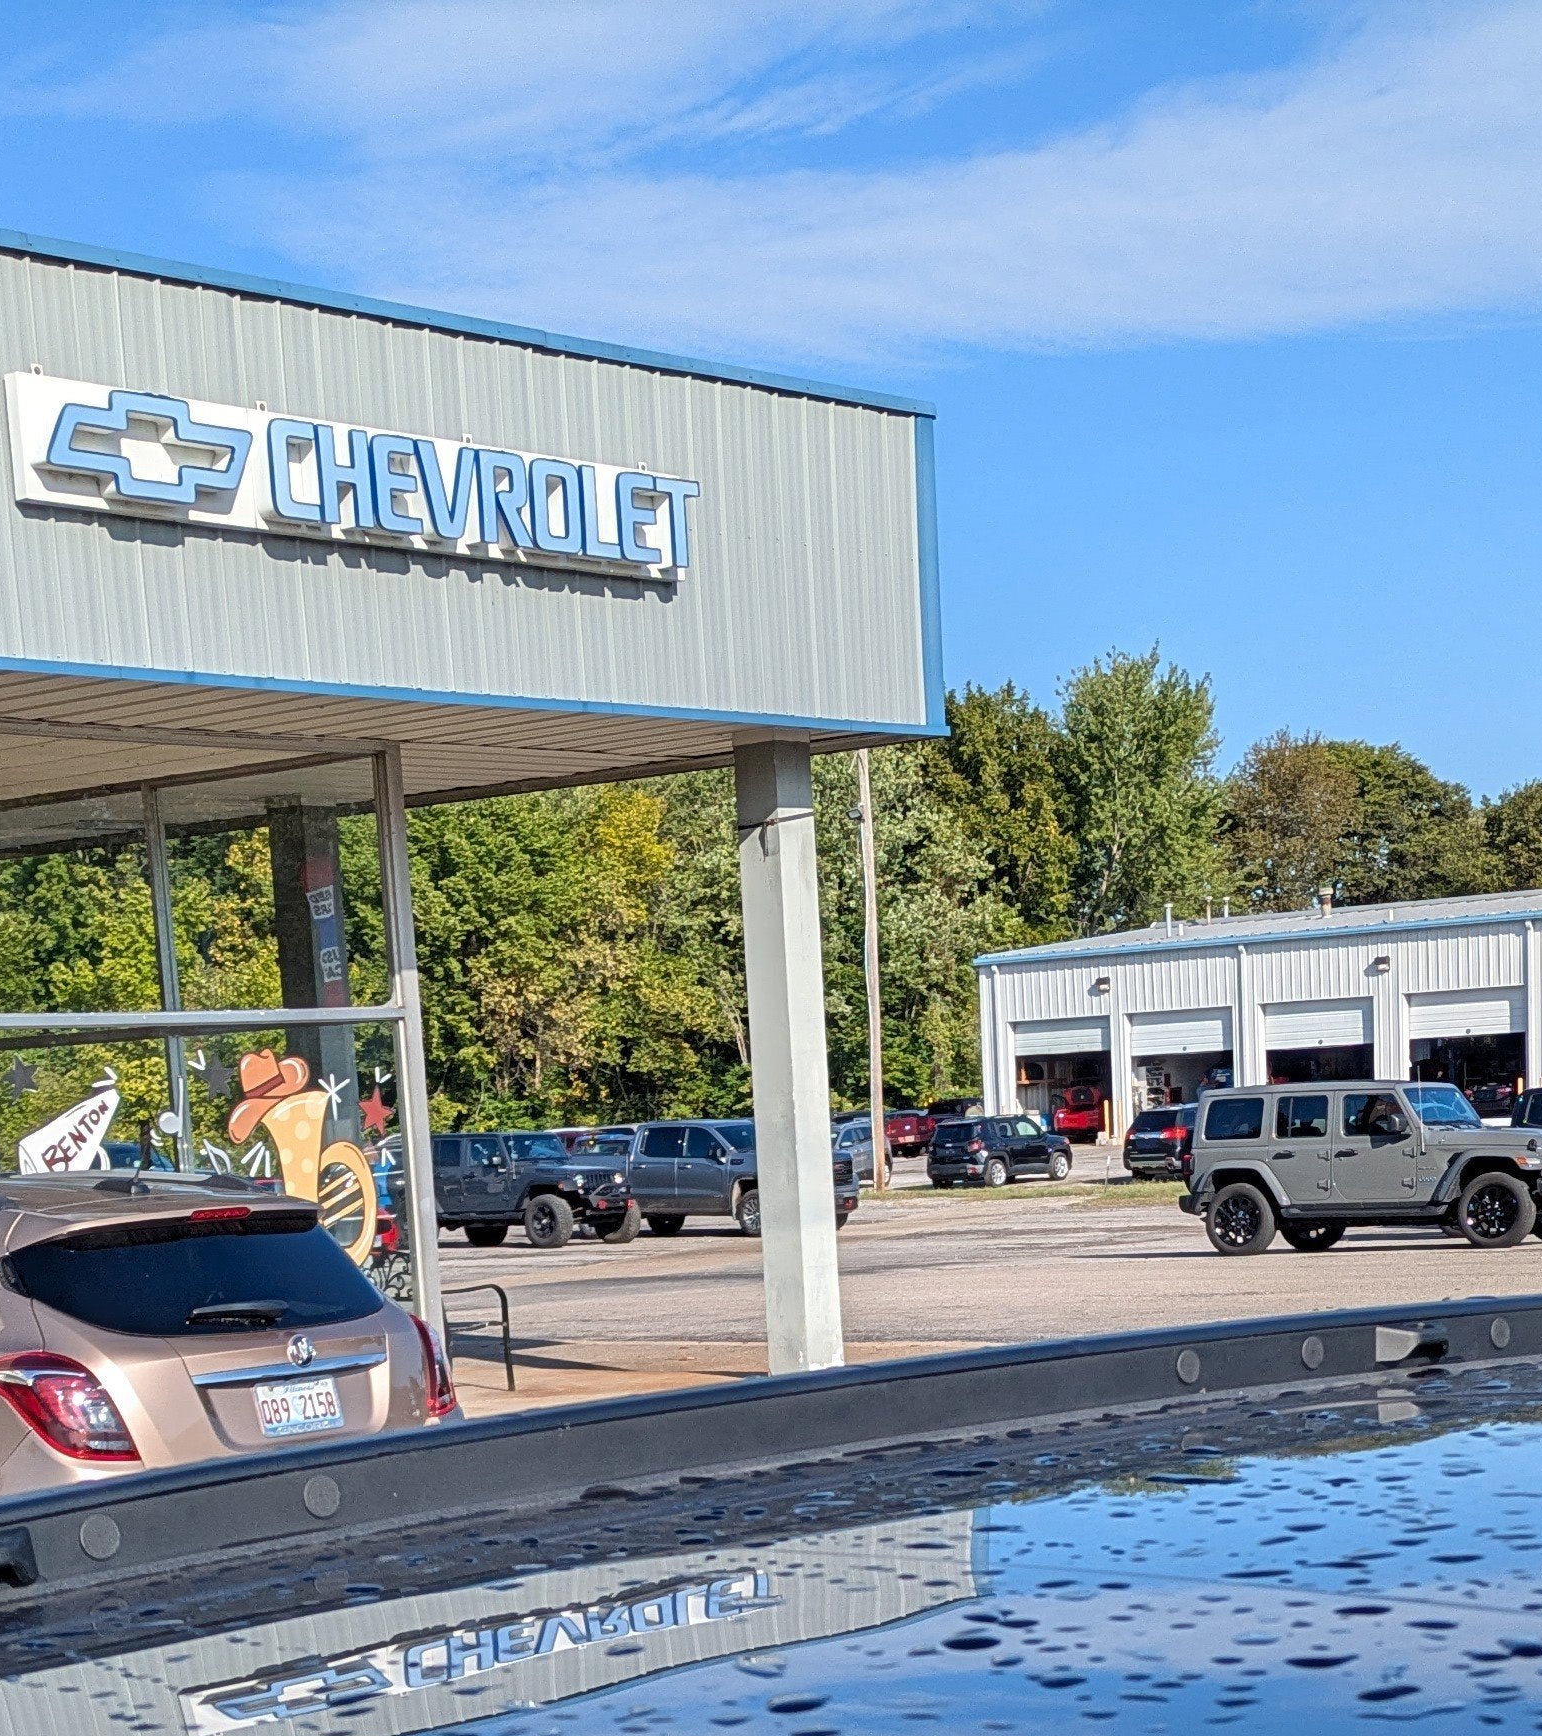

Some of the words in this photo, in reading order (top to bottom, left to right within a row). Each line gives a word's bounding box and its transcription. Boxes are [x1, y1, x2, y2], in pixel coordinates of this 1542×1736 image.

[268, 417, 700, 568] CHEVROLET
[41, 1100, 109, 1172] BENTON
[299, 1391, 337, 1420] 2158
